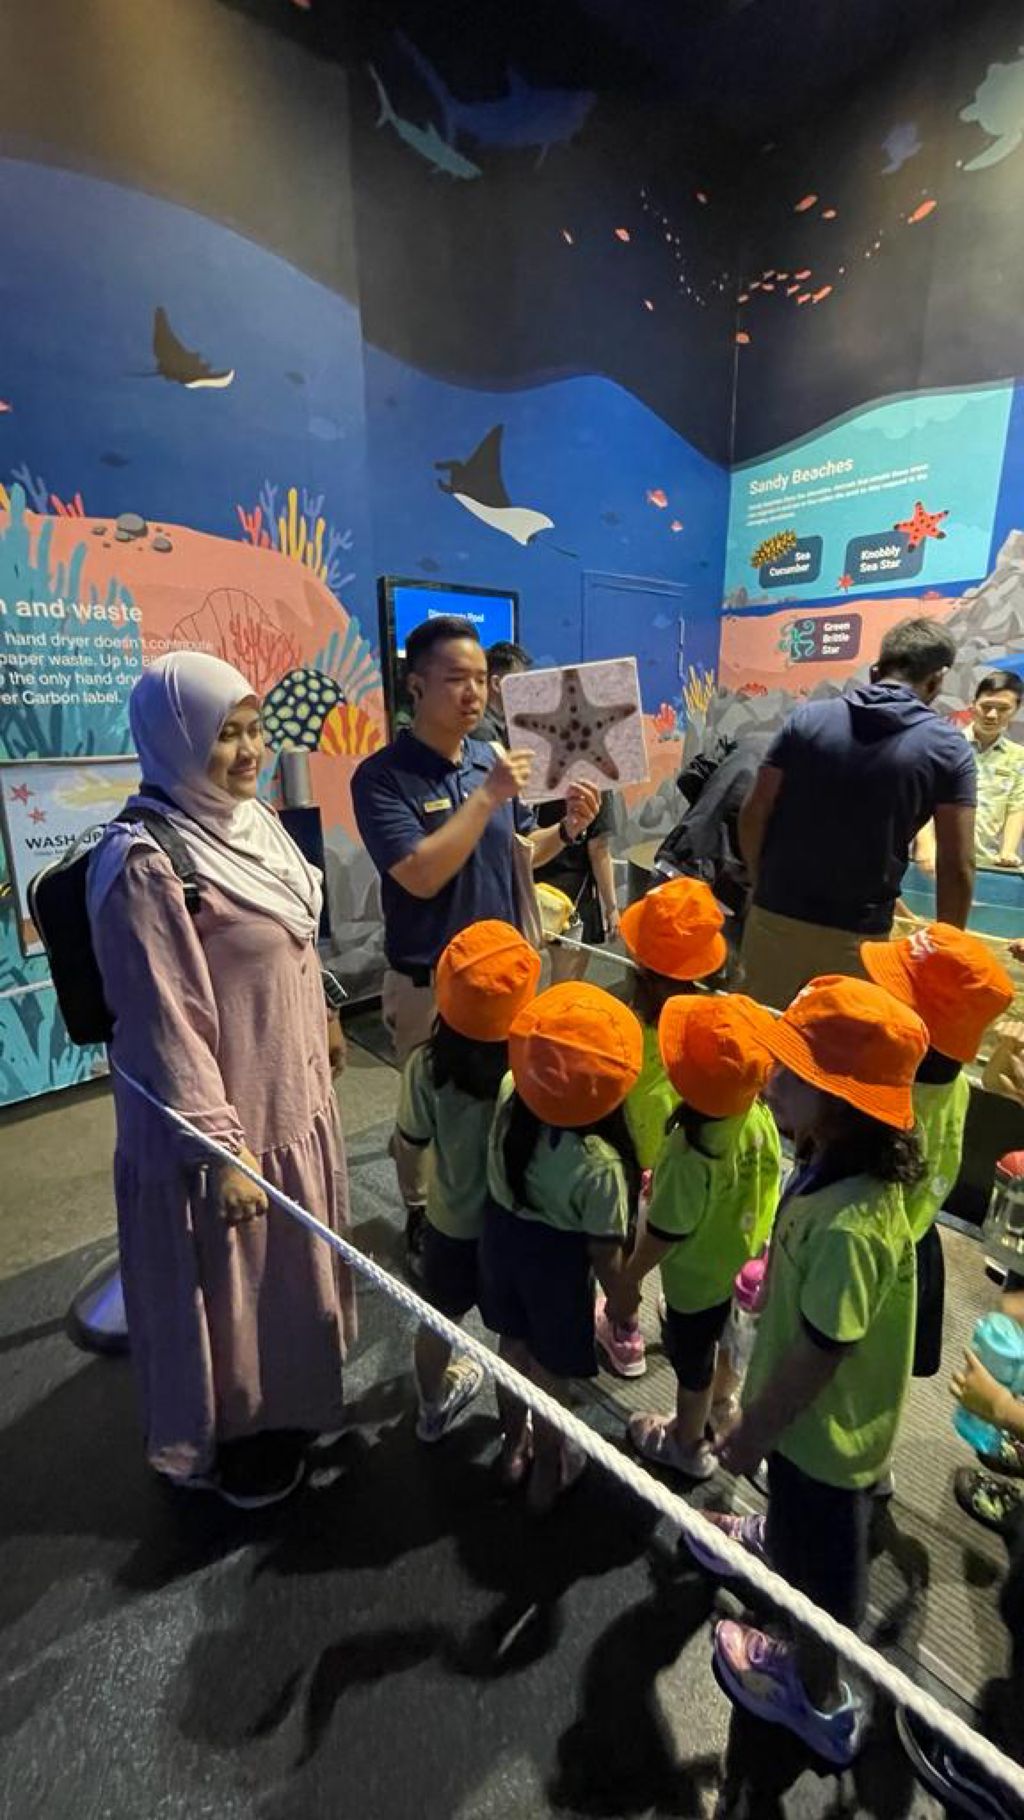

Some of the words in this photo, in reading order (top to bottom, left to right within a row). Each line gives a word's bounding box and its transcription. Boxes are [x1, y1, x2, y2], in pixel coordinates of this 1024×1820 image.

[749, 472, 789, 495] Sandy
[791, 458, 854, 484] Beaches
[861, 546, 901, 561] Knobbly
[860, 562, 878, 573] Sea
[880, 559, 901, 570] Star
[16, 598, 65, 619] and
[72, 602, 143, 622] waste
[823, 622, 851, 632] Green
[4, 631, 47, 646] hand
[50, 633, 90, 651] dryer
[823, 633, 850, 643] Brittle
[822, 645, 840, 655] Star
[101, 653, 121, 669] Up
[124, 655, 138, 667] to
[9, 671, 35, 685] the
[39, 671, 72, 689] only
[75, 671, 112, 685] hand
[22, 690, 79, 705] Carbon
[25, 833, 76, 849] WASH
